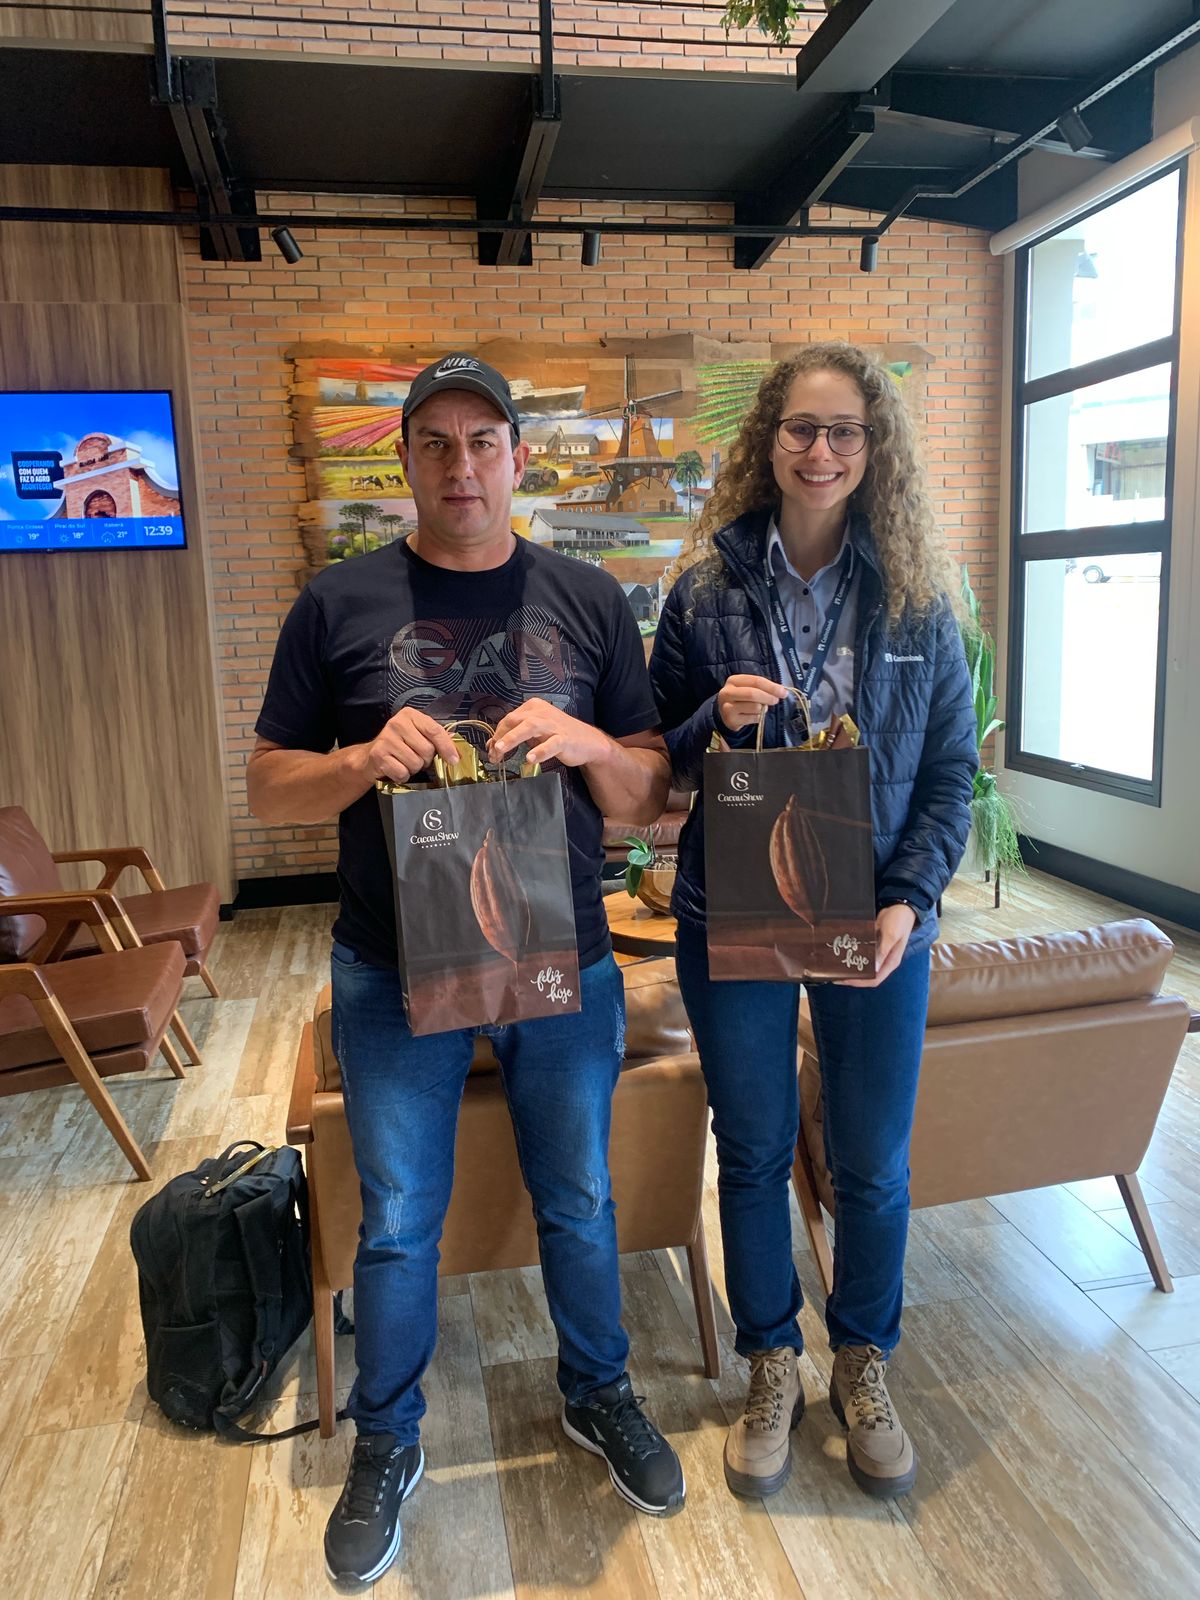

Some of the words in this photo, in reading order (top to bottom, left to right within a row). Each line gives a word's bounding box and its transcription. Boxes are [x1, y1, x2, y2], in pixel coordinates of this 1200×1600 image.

[443, 357, 480, 369] NIKE
[18, 468, 31, 476] COM
[32, 468, 49, 476] QUEM
[20, 475, 30, 484] FAZ
[35, 475, 51, 483] AGRO
[143, 525, 174, 537] 12:39
[841, 949, 869, 971] hoje
[530, 966, 565, 992] feliz
[546, 982, 573, 1004] hoje
